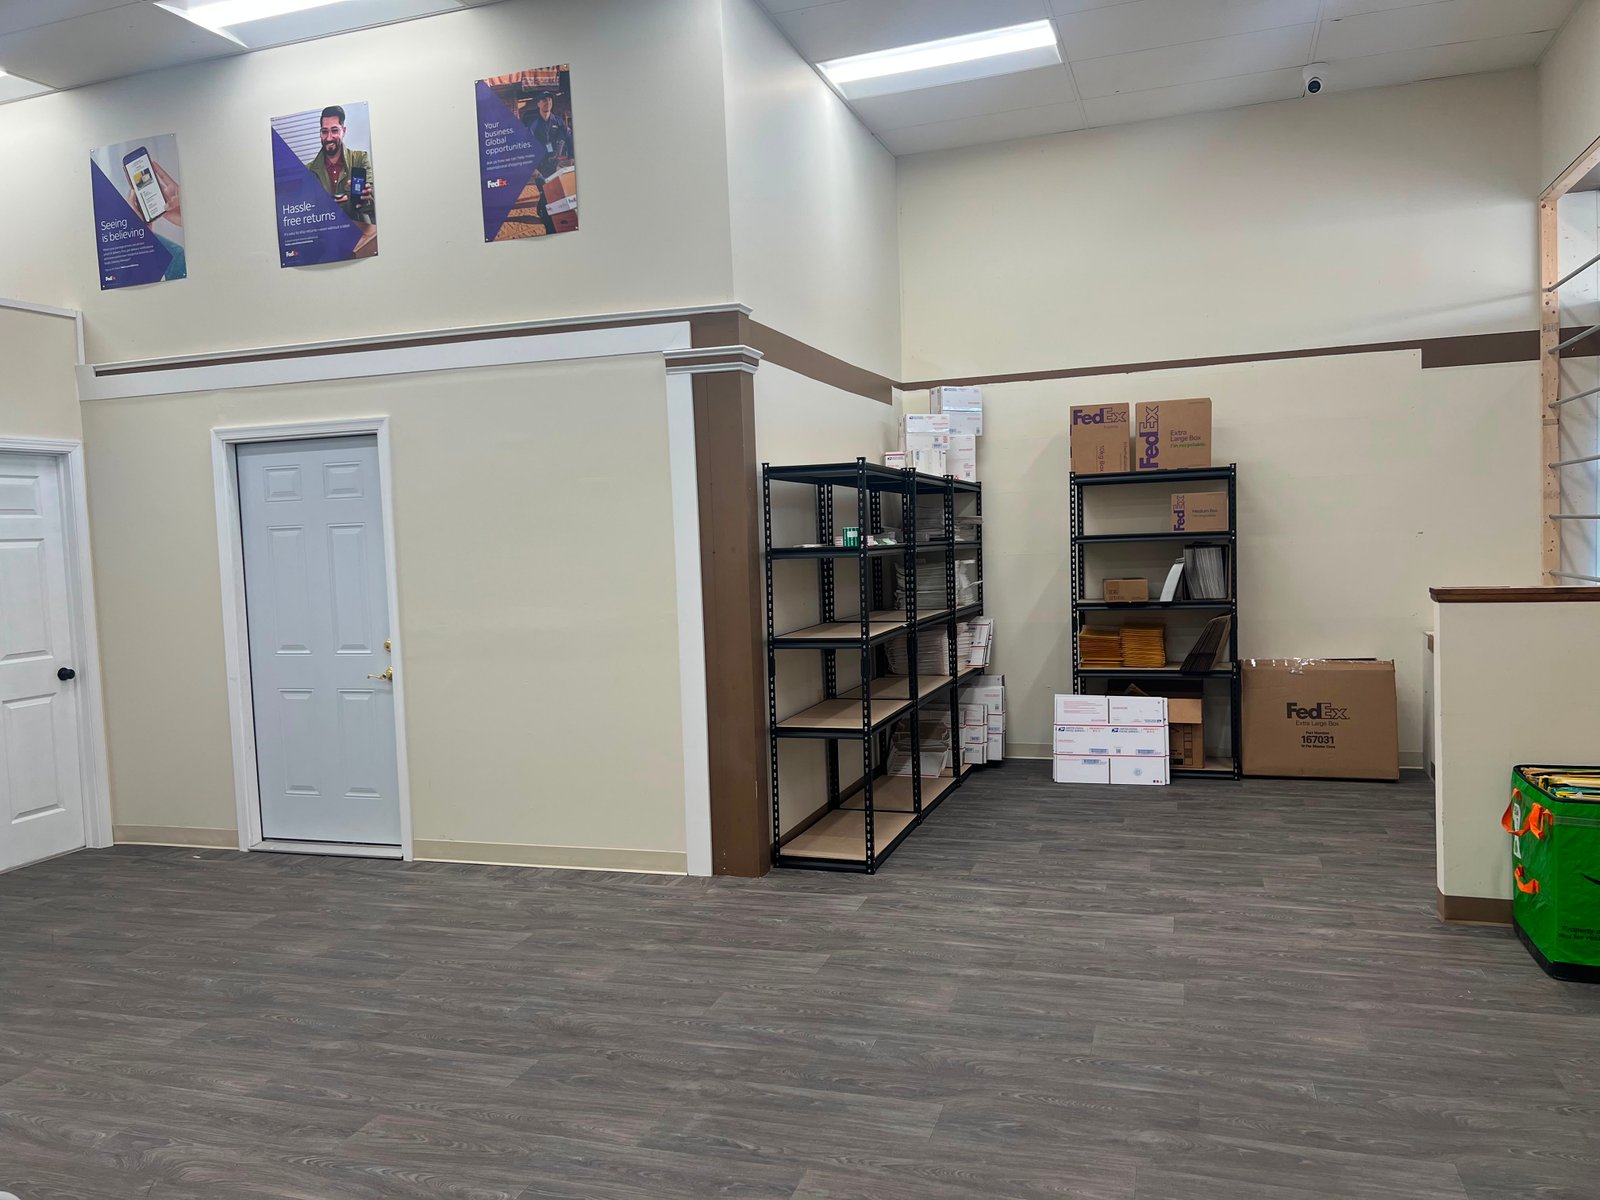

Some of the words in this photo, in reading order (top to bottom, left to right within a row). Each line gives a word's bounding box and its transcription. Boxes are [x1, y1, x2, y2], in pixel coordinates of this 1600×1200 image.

[485, 127, 514, 138] business.
[485, 137, 507, 146] Global
[486, 141, 532, 155] opportunities.
[487, 178, 507, 188] FedEx
[282, 201, 316, 214] Hassle-
[101, 219, 127, 231] Seeing
[283, 215, 301, 226] free
[303, 211, 336, 224] returns
[102, 233, 108, 242] is
[109, 228, 144, 241] believing
[1073, 407, 1127, 425] FedEx
[1139, 405, 1159, 469] FedEx
[1170, 435, 1188, 443] Large
[1173, 495, 1185, 531] FedEx
[1286, 702, 1348, 719] FedEx
[1301, 735, 1334, 744] 167031
[1562, 925, 1593, 934] Property
